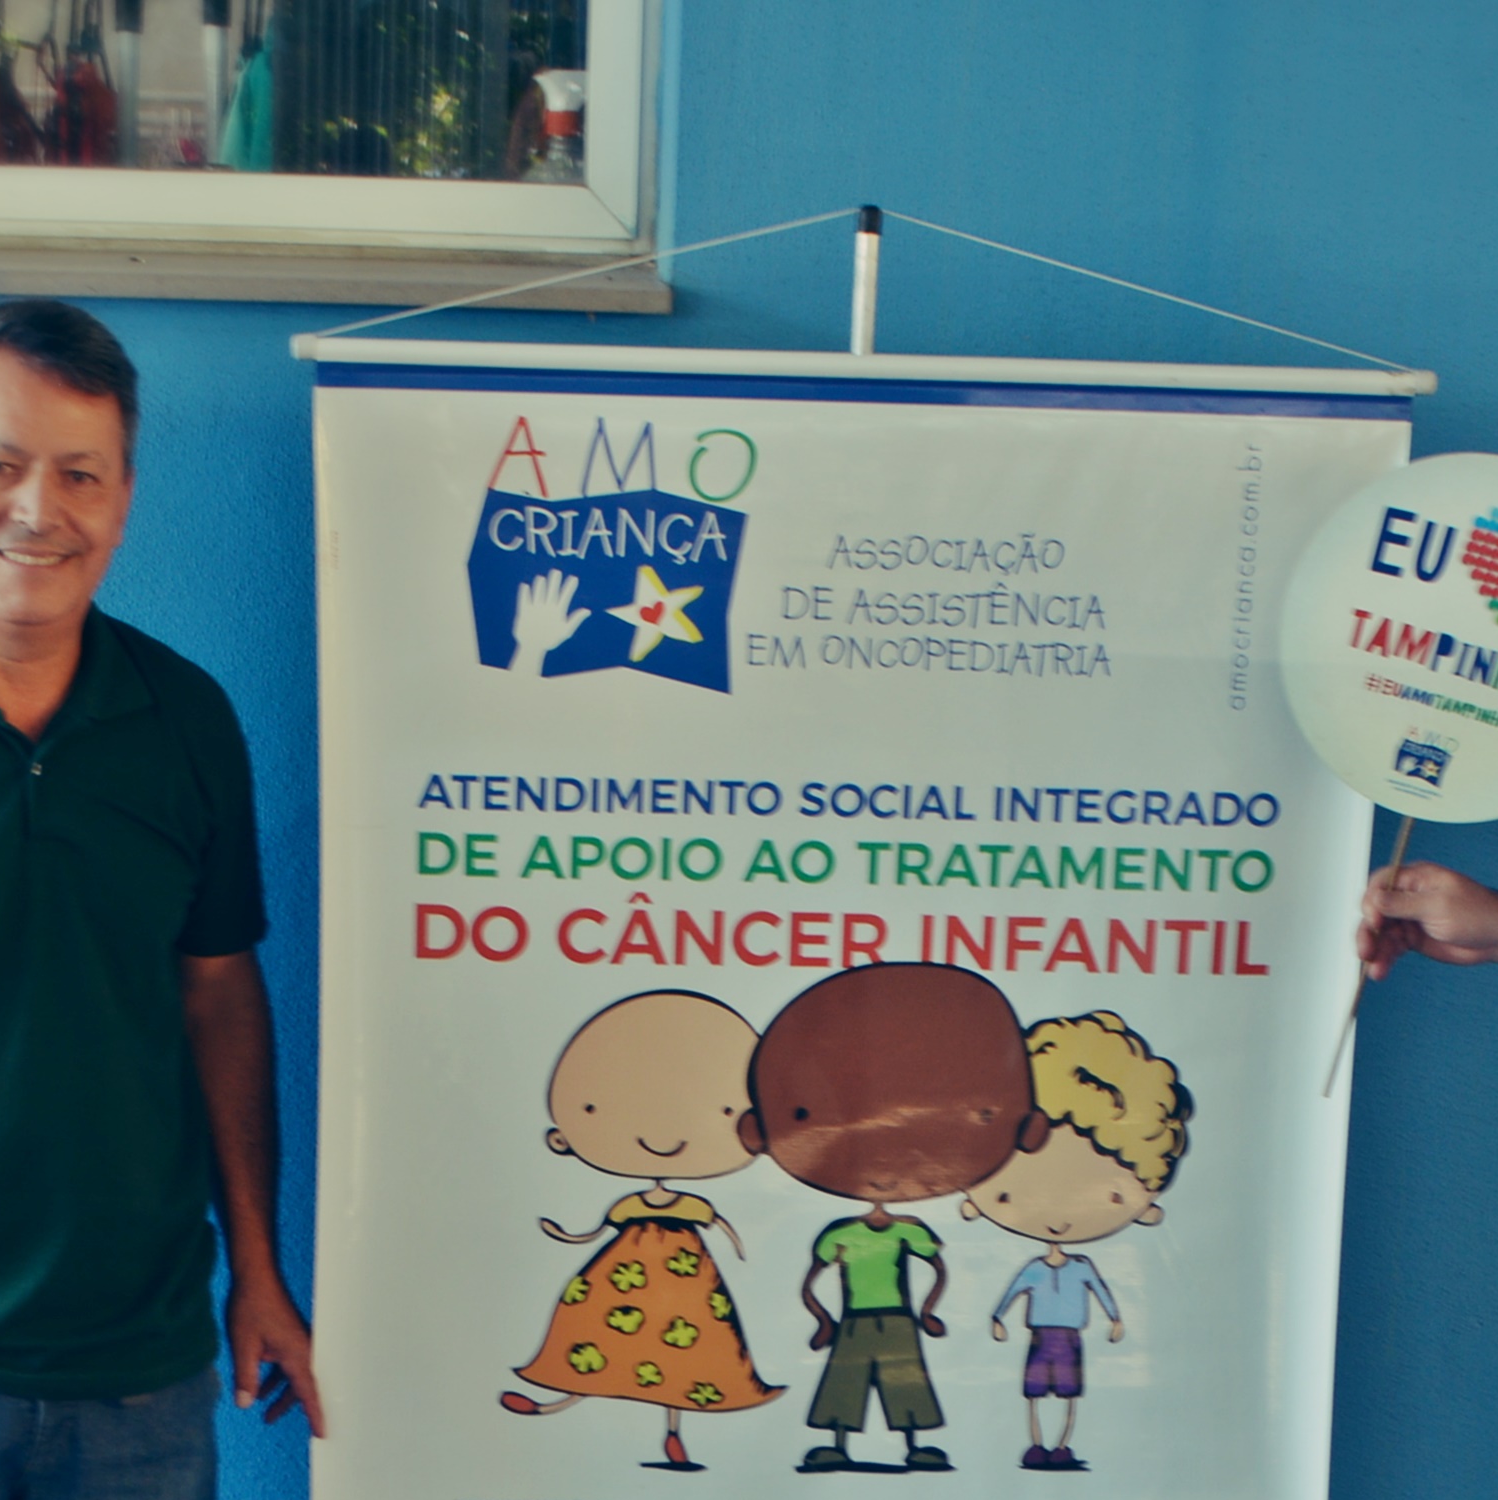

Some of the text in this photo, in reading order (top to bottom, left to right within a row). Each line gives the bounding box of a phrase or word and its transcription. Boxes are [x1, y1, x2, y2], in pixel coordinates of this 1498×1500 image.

[488, 416, 757, 501] AMO
[488, 507, 728, 567] CRIANÇA
[825, 533, 1065, 576] ASSOCIAÇÃO
[1370, 507, 1457, 582] EU
[780, 584, 1106, 631] DE ASSISTÊNCIA
[1227, 443, 1263, 712] amocrianca.com.br
[745, 633, 1112, 678] EM ONCOPEDIATRIA
[419, 774, 1280, 828] ATENDIMENTO SOCIAL INTEGRADO
[416, 832, 1275, 893] DE APOIO AO TRATAMENTO
[414, 893, 1270, 977] DO CÂNCER INFANTIL
